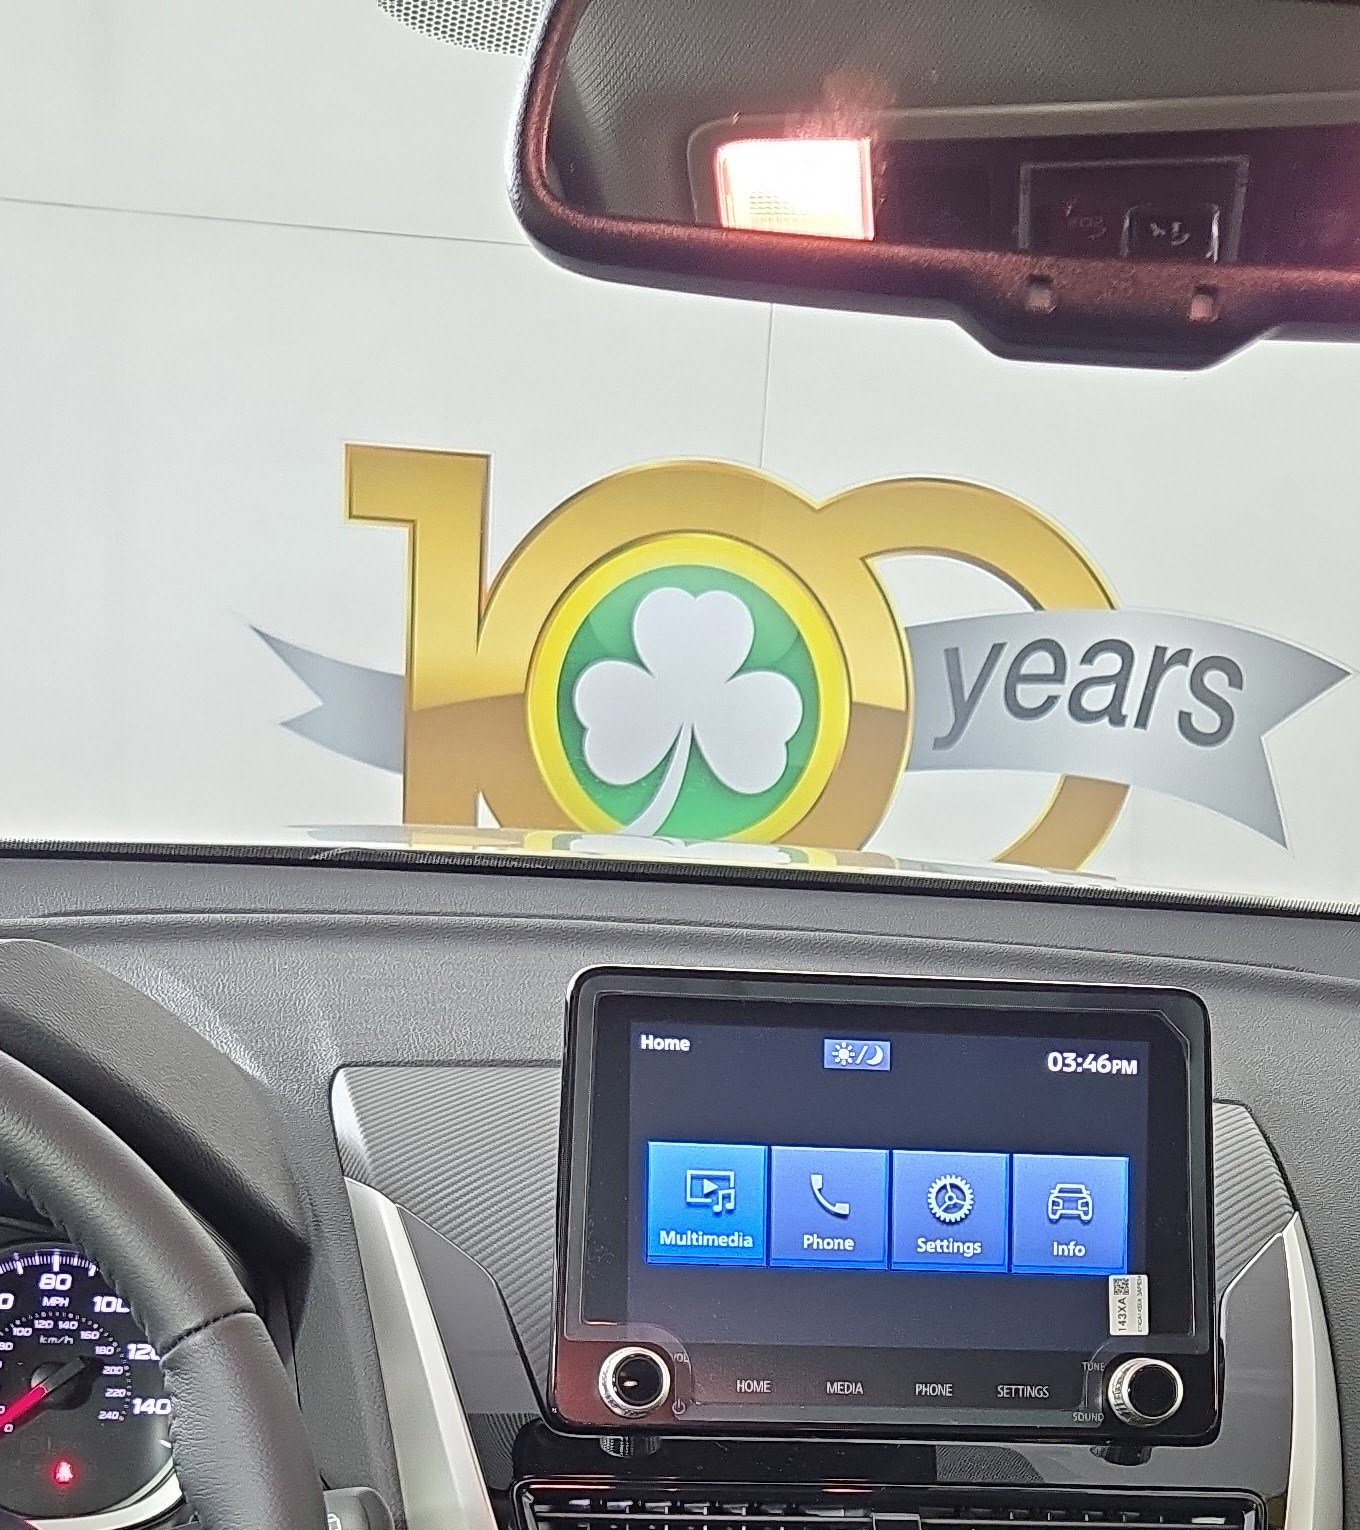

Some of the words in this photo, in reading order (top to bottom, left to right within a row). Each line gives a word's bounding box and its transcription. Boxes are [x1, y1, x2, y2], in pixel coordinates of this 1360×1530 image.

[933, 635, 1244, 751] years
[641, 1033, 690, 1053] Home
[1047, 1052, 1138, 1076] 03:46PM
[659, 1229, 754, 1250] Multimedia
[802, 1233, 855, 1252] Phone
[916, 1236, 982, 1257] Settings
[1052, 1240, 1086, 1258] Info
[39, 1274, 72, 1290] 80
[42, 1297, 69, 1307] MPH
[1117, 1297, 1127, 1332] 143XA
[33, 1319, 54, 1330] 120
[57, 1320, 78, 1331] 140
[12, 1327, 33, 1337] 100
[40, 1334, 73, 1345] km/h
[671, 1352, 690, 1363] VOL
[102, 1365, 124, 1375] 200
[1082, 1361, 1105, 1372] TUNE
[105, 1387, 127, 1397] 220
[736, 1379, 772, 1393] HOME
[826, 1381, 864, 1395] MEDIA
[915, 1383, 953, 1397] PHONE
[997, 1385, 1050, 1398] SETTINGS
[132, 1398, 171, 1415] 140
[98, 1411, 120, 1420] 240
[1072, 1411, 1105, 1423] SOUND
